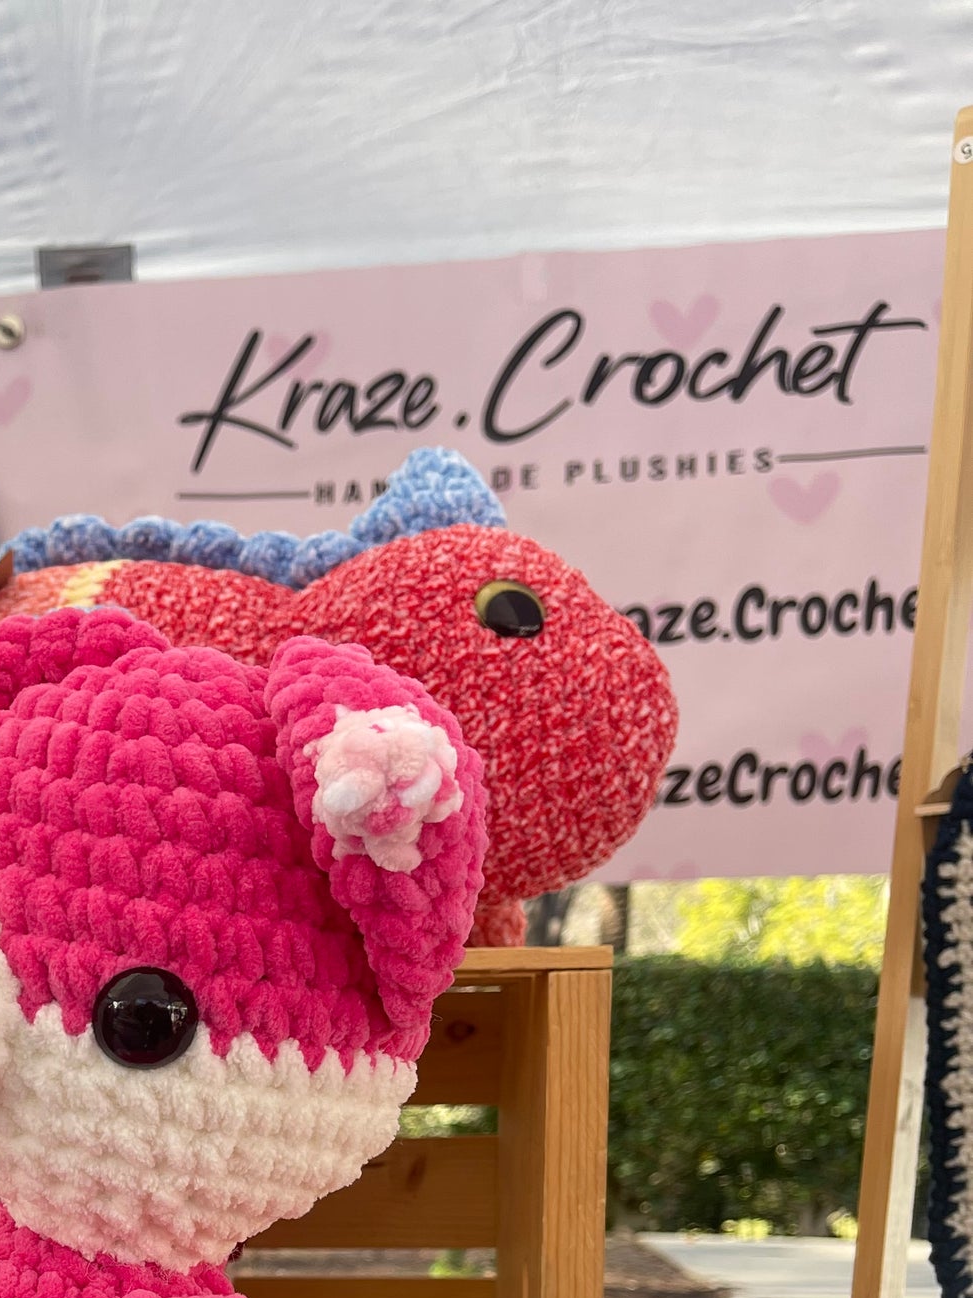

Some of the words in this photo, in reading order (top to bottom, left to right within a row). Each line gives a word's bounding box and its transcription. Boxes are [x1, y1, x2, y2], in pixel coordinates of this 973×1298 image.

[314, 464, 539, 505] HANDE
[564, 447, 774, 486] PLUSHIES
[619, 578, 917, 643] aze.Croche
